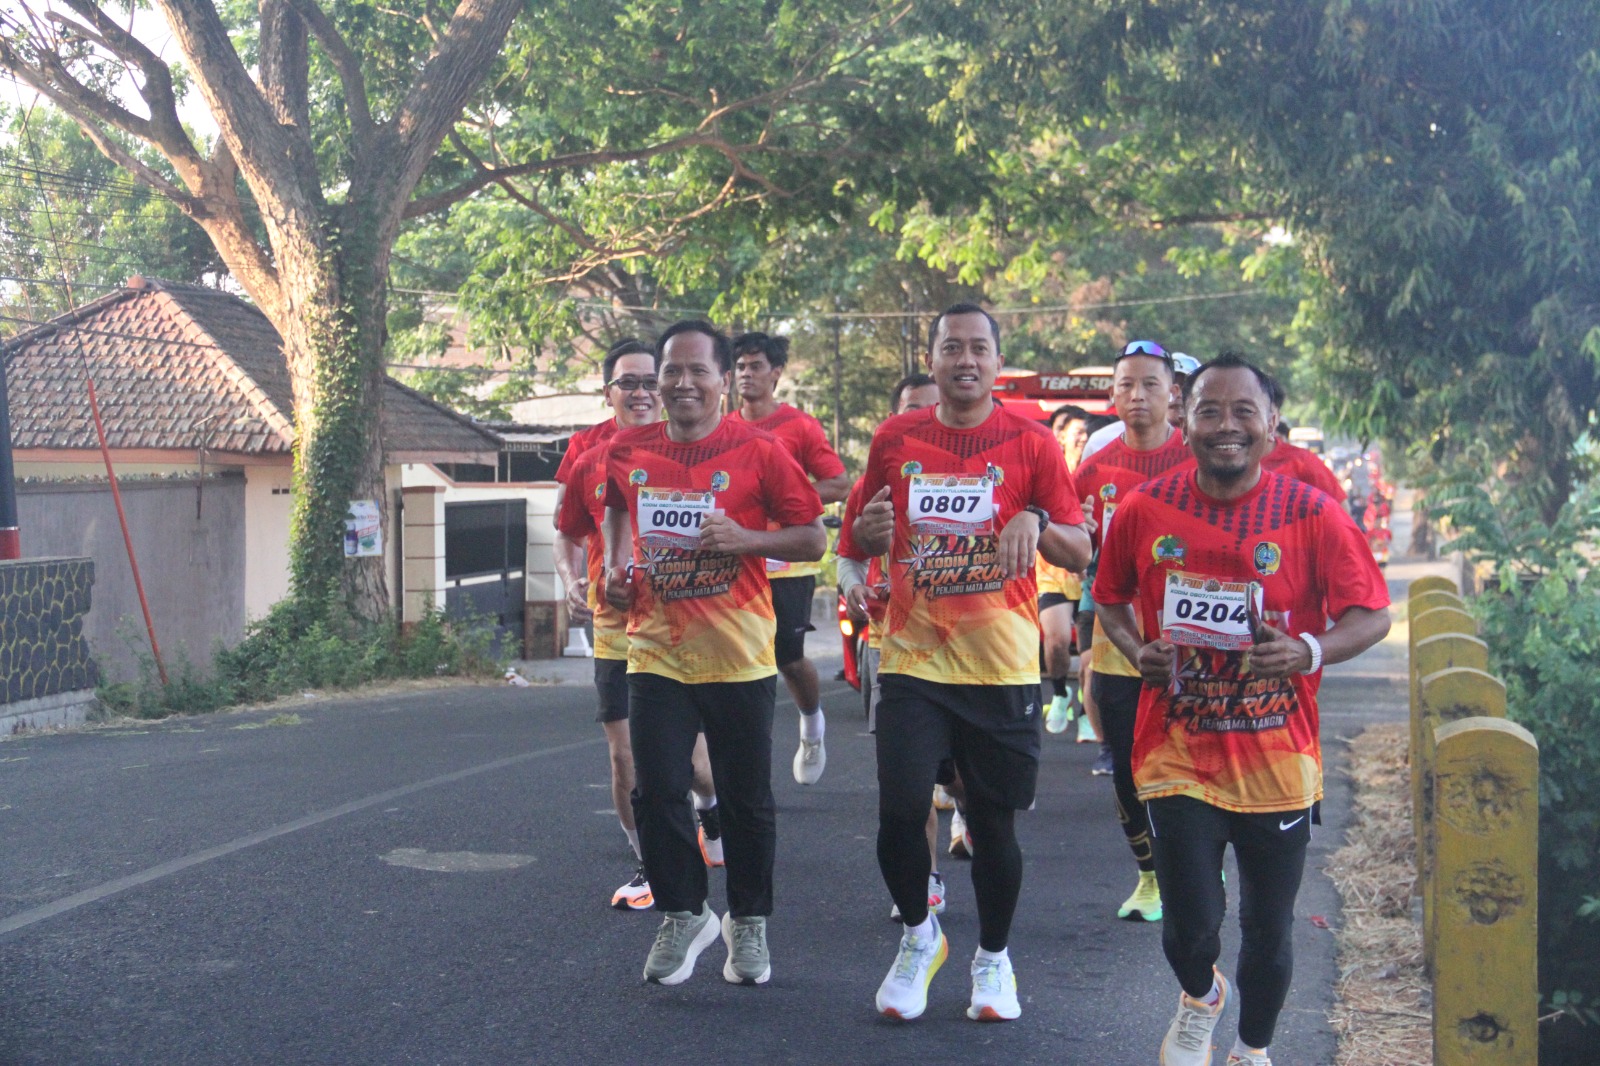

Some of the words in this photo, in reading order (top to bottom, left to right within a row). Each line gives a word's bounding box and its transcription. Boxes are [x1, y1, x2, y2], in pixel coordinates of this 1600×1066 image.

[1040, 376, 1114, 390] TERPESO
[919, 495, 981, 513] 0807
[652, 509, 702, 528] 0001
[658, 560, 696, 575] KODIM
[926, 554, 968, 570] KODIM
[653, 573, 691, 590] FUN
[694, 566, 737, 587] RUN
[916, 568, 963, 586] FUN
[1181, 578, 1204, 589] FUN
[927, 585, 935, 600] 4
[966, 582, 983, 592] MATA
[984, 581, 1002, 591] ANGIN
[1170, 588, 1189, 596] KODIM
[1176, 598, 1246, 624] 0204
[1187, 680, 1238, 697] KODIM
[1174, 695, 1229, 718] FUN
[1234, 693, 1296, 717] RUN
[1189, 715, 1199, 731] 4
[1257, 715, 1284, 727] ANGIN
